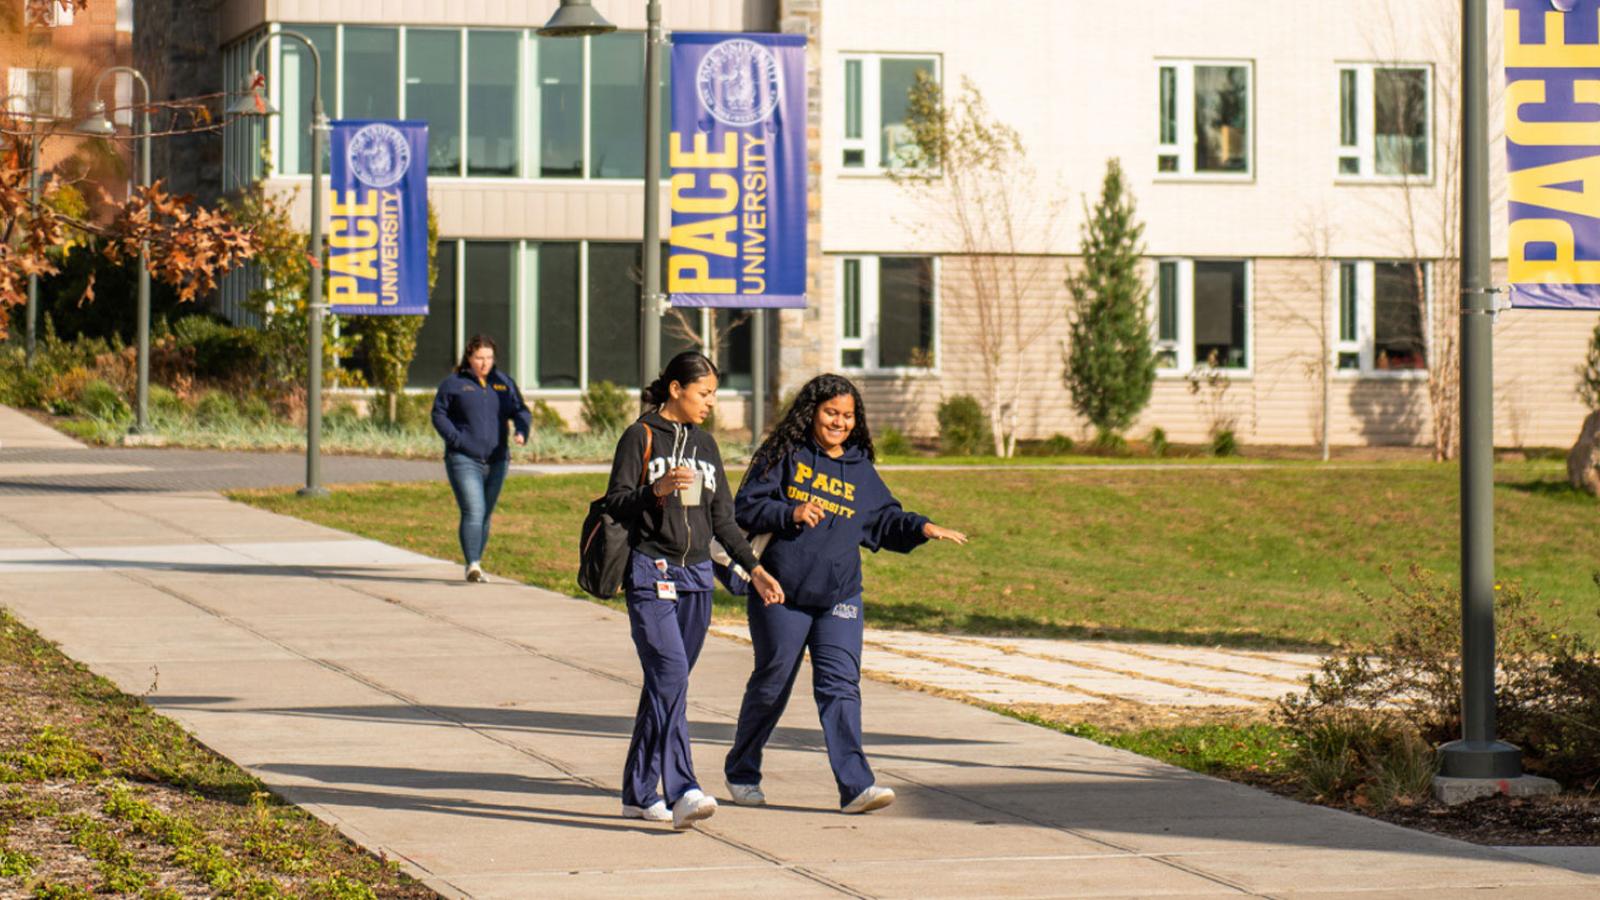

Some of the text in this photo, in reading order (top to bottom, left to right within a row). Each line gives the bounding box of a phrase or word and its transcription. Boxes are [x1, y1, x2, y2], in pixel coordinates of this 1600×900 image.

[1504, 9, 1600, 284] PACE
[328, 190, 378, 305] PACE
[381, 191, 399, 305] UNIVERSITY
[669, 132, 739, 294] PACE
[742, 134, 767, 294] UNIVERSITY
[787, 485, 856, 519] UNIVERSITY
[793, 462, 855, 501] PACE
